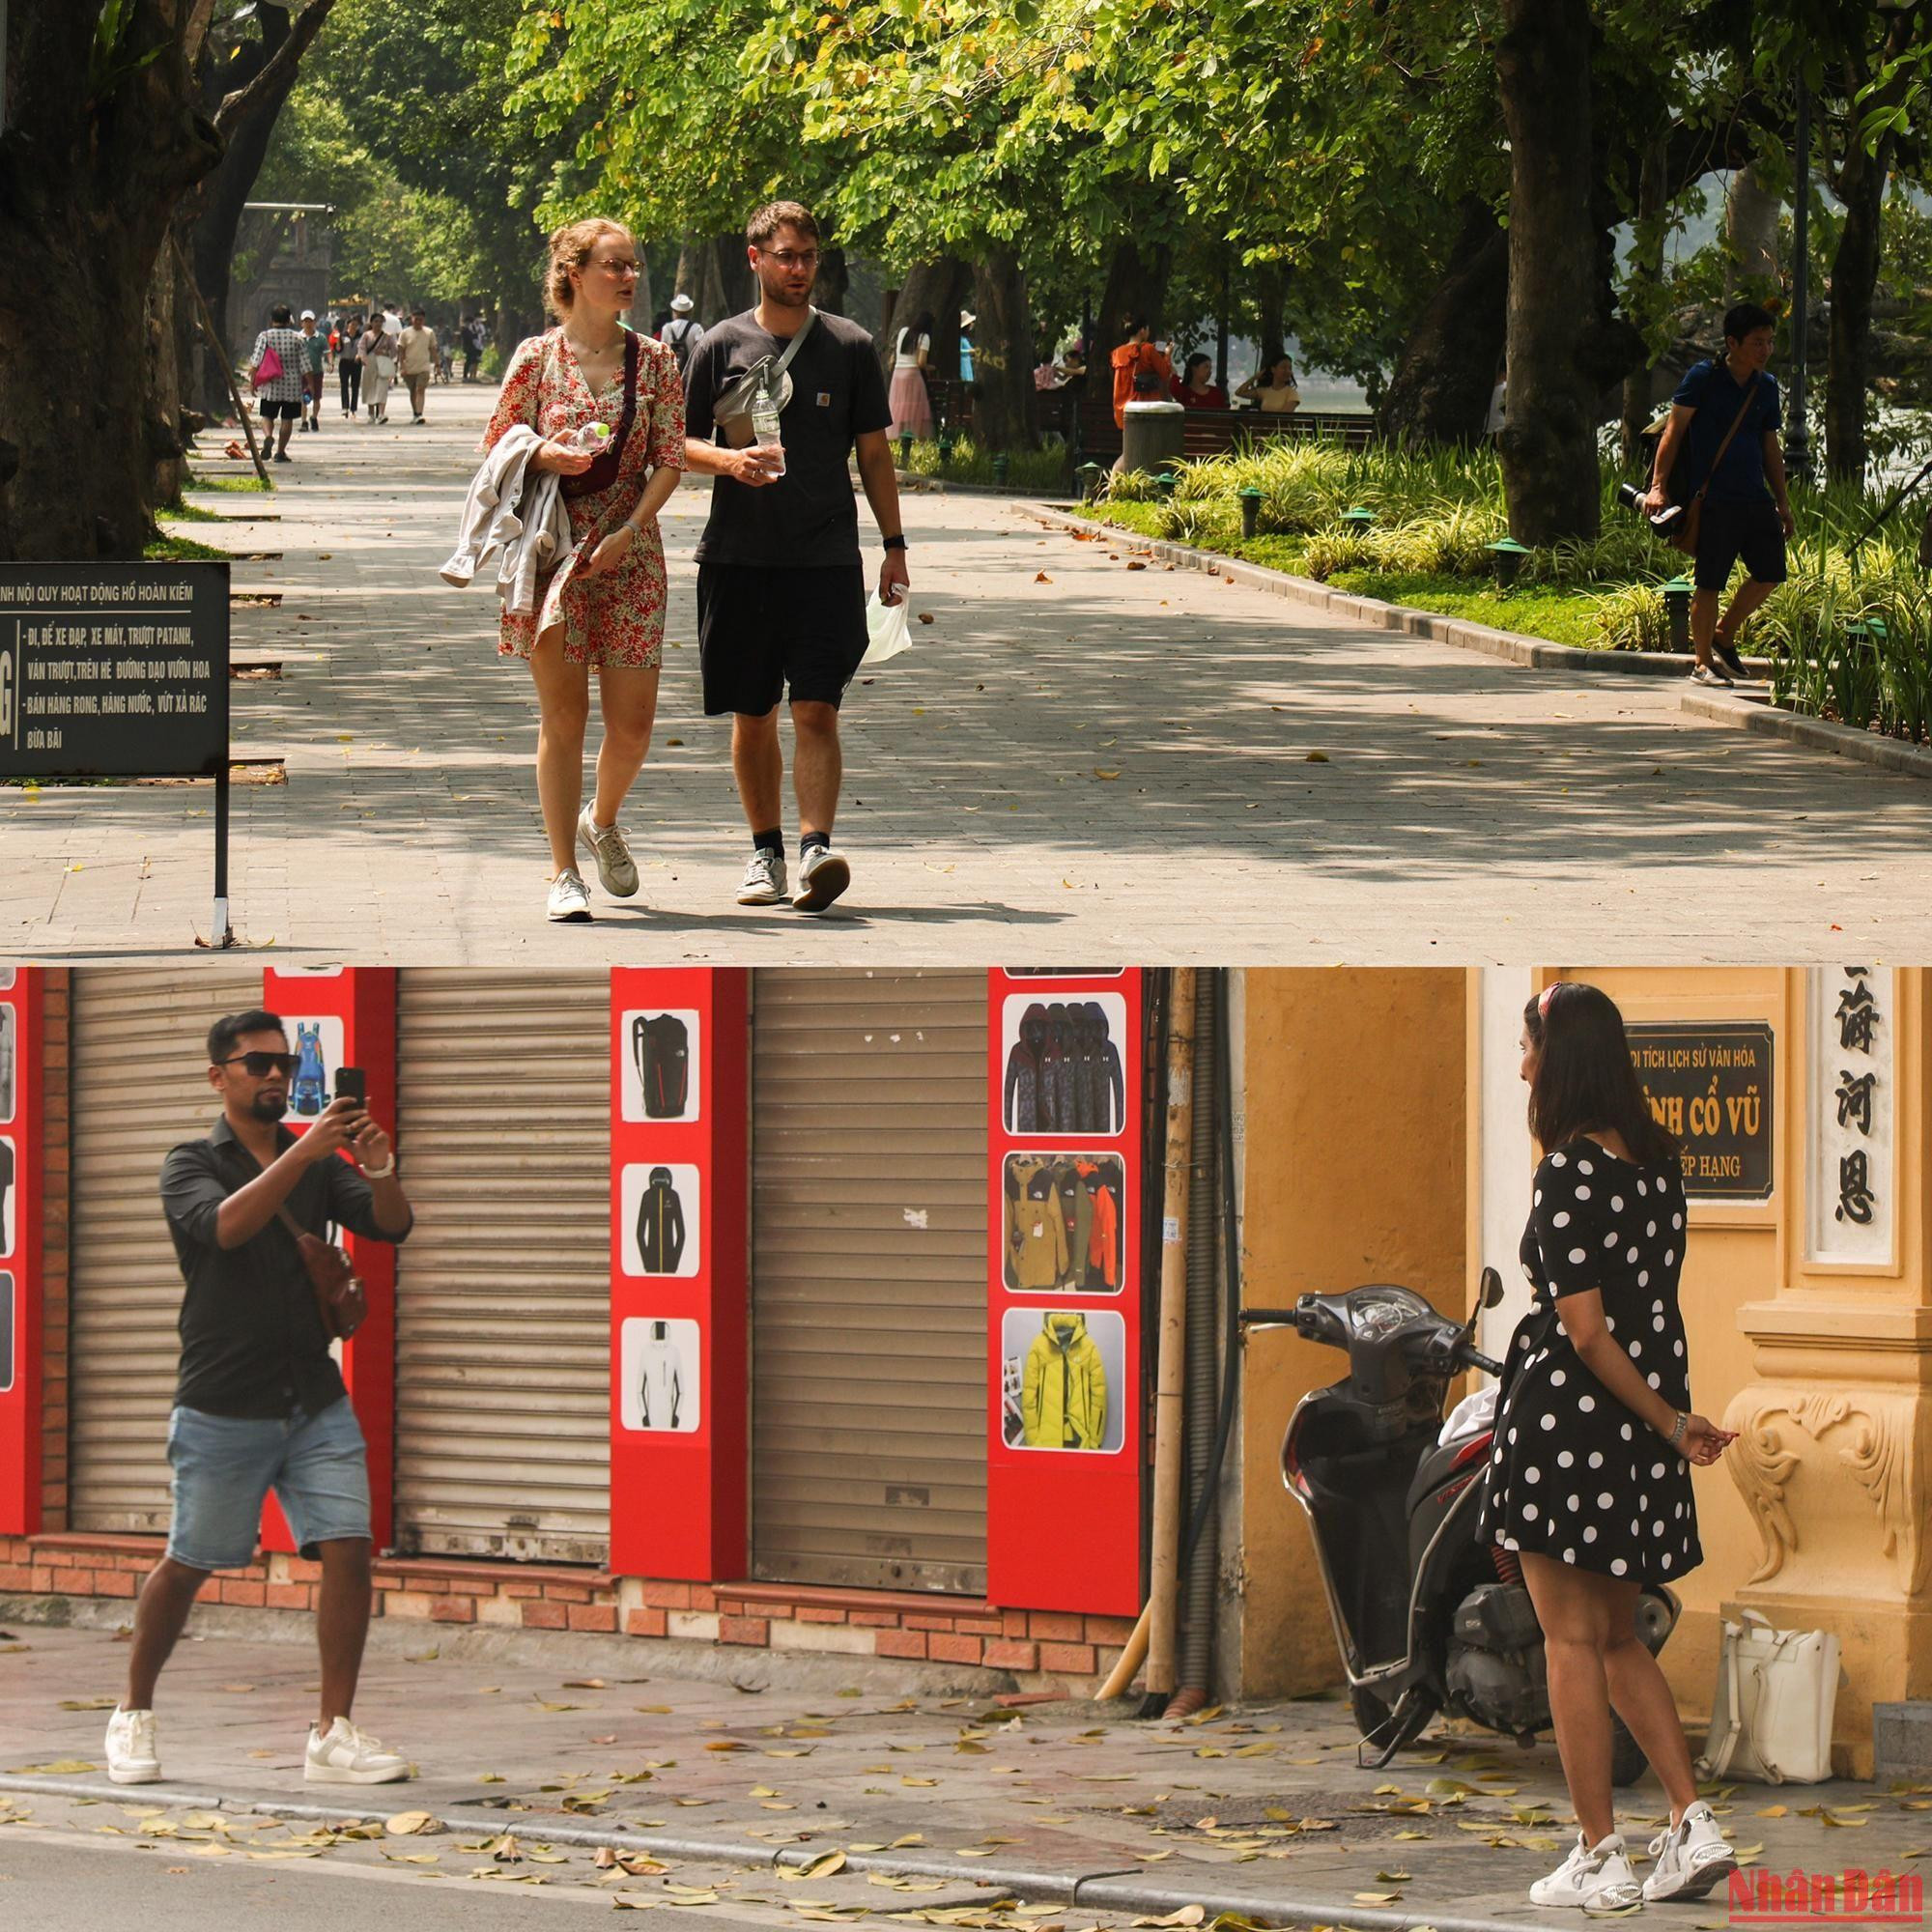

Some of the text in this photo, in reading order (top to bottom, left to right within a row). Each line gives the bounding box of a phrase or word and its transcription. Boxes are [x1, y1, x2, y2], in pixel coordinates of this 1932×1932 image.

[17, 582, 35, 606] NỘI
[38, 585, 58, 602] QUY
[61, 585, 89, 606] HOẠT
[90, 582, 119, 606] ĐỘNG
[139, 582, 167, 601] HOÀN
[169, 581, 193, 601] KIẾM
[56, 627, 67, 645] XE
[91, 627, 102, 645] XE
[156, 627, 193, 647] PATANH,
[148, 661, 165, 683] DẠO
[192, 661, 211, 679] HOA
[27, 692, 45, 714] BÁN
[47, 692, 71, 714] HÀNG
[101, 692, 127, 713] HÀNG
[157, 690, 174, 713] VỨT
[189, 691, 208, 713] RÁC
[46, 726, 63, 749] BÃI
[1643, 1045, 1665, 1067] TÍCH
[1667, 1049, 1690, 1073] LỊCH
[1692, 1041, 1707, 1067] SỬ
[1709, 1044, 1731, 1067] VĂN
[1733, 1044, 1756, 1066] HÓA
[1690, 1074, 1720, 1136] CỔ
[1725, 1085, 1761, 1136] VŨ
[1699, 1154, 1741, 1183] HẠNG
